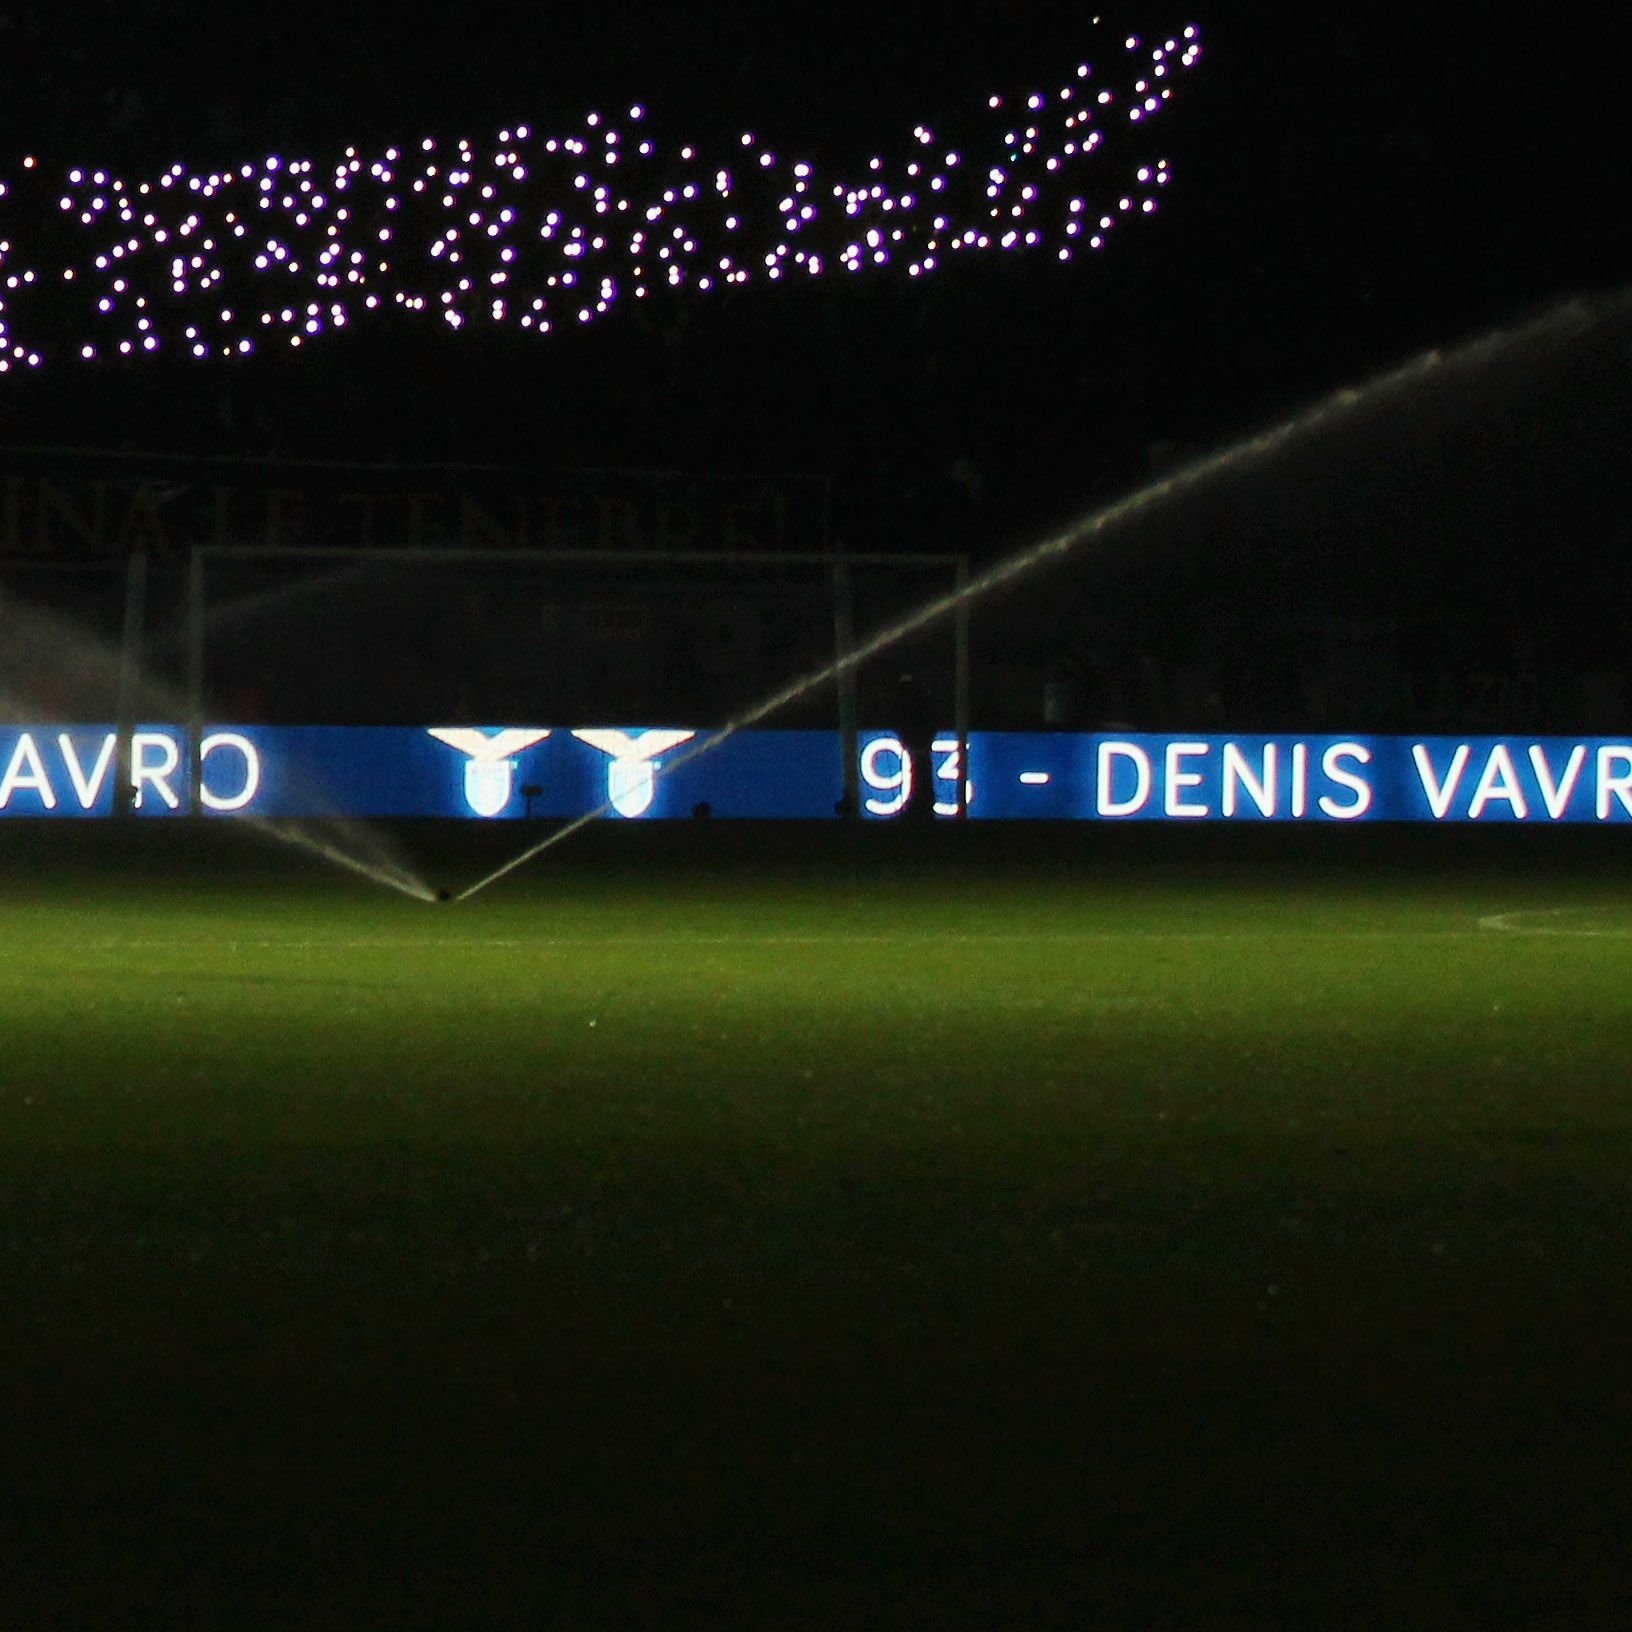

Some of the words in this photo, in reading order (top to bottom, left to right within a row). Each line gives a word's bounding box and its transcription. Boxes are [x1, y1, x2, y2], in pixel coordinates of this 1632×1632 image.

[860, 737, 974, 816] 93
[1019, 772, 1051, 785] -
[1096, 741, 1373, 821] DENIS
